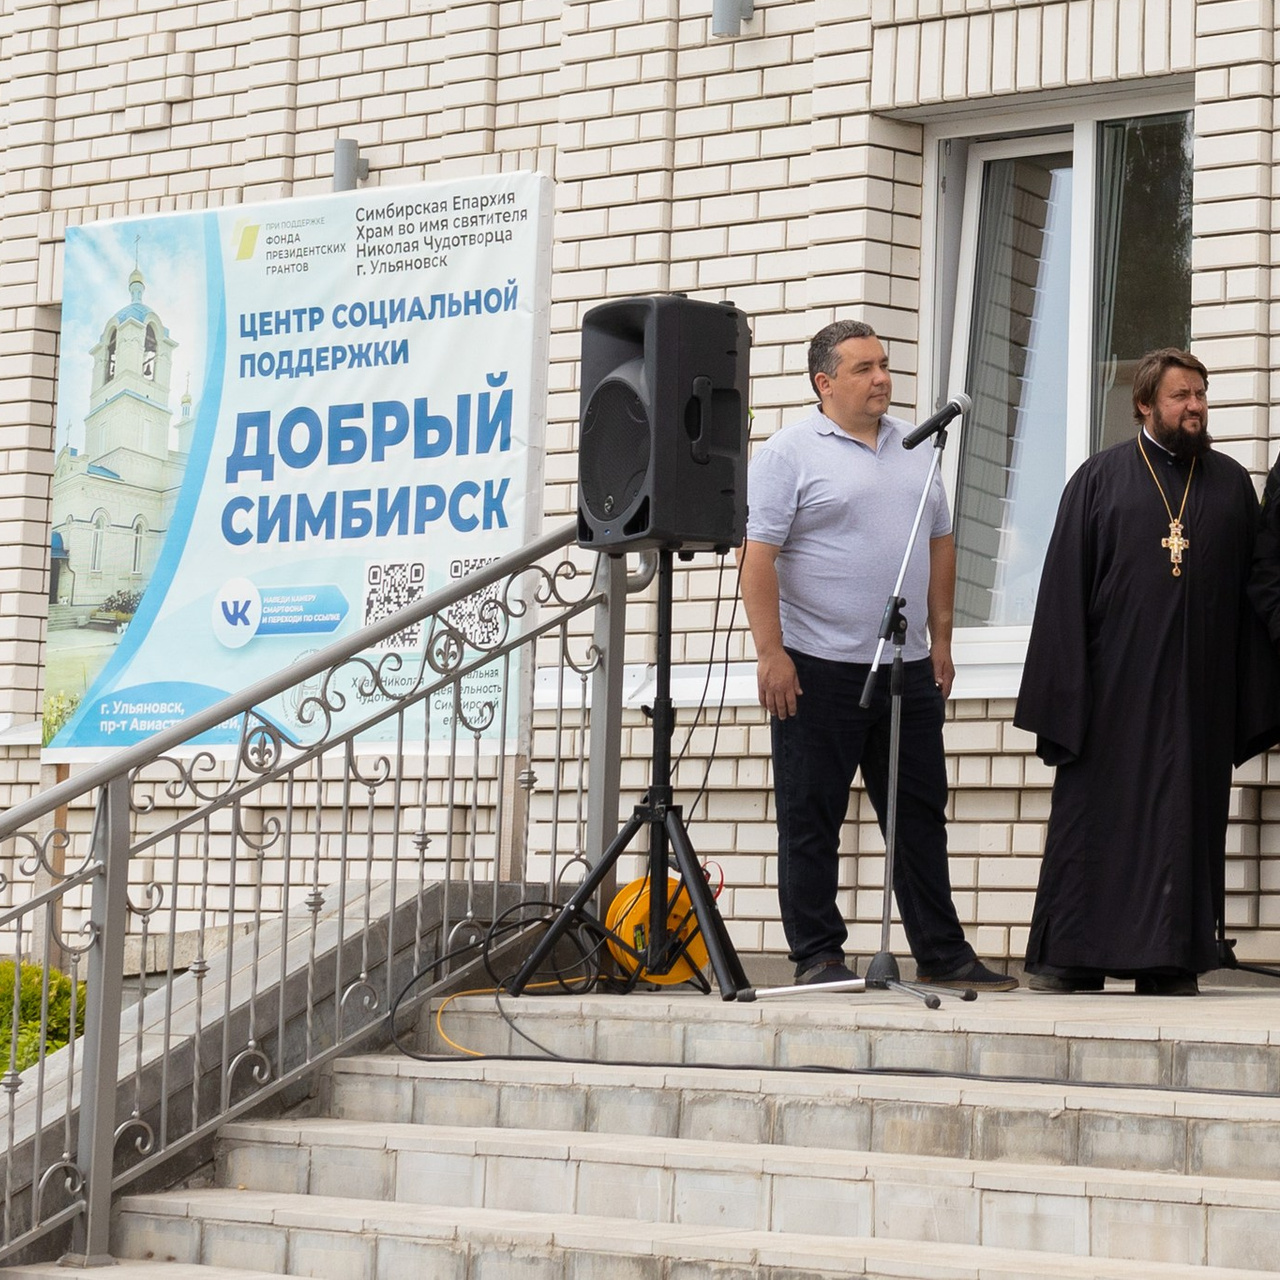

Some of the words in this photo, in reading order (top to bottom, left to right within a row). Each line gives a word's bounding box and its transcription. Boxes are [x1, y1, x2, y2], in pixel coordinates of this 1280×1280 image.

[355, 199, 448, 222] Симбирская
[452, 192, 515, 212] Епархия
[265, 223, 280, 231] ПРИ
[281, 217, 325, 229] ПОДДЕРЖКЕ
[356, 222, 394, 241] Храм
[398, 222, 415, 236] во
[419, 217, 448, 233] имя
[452, 208, 528, 230] святителя
[266, 233, 301, 245] ФОНДА
[266, 243, 346, 261] ПРЕЗИДЕНТСКИХ
[356, 239, 419, 258] Николая
[423, 228, 512, 252] Чудотворца
[266, 262, 309, 276] ГРАНТОВ
[356, 263, 366, 276] г.
[370, 254, 448, 275] Ульяновск
[240, 306, 325, 341] ЦЕНТР
[332, 278, 518, 330] СОЦИАЛЬНОЙ
[239, 339, 410, 380] ПОДДЕРЖКИ
[225, 371, 513, 484] ДОБРЫЙ
[221, 477, 511, 546] СИМБИРСК
[101, 703, 110, 715] г.
[112, 700, 185, 715] Ульяновск,
[101, 720, 126, 734] пр-т
